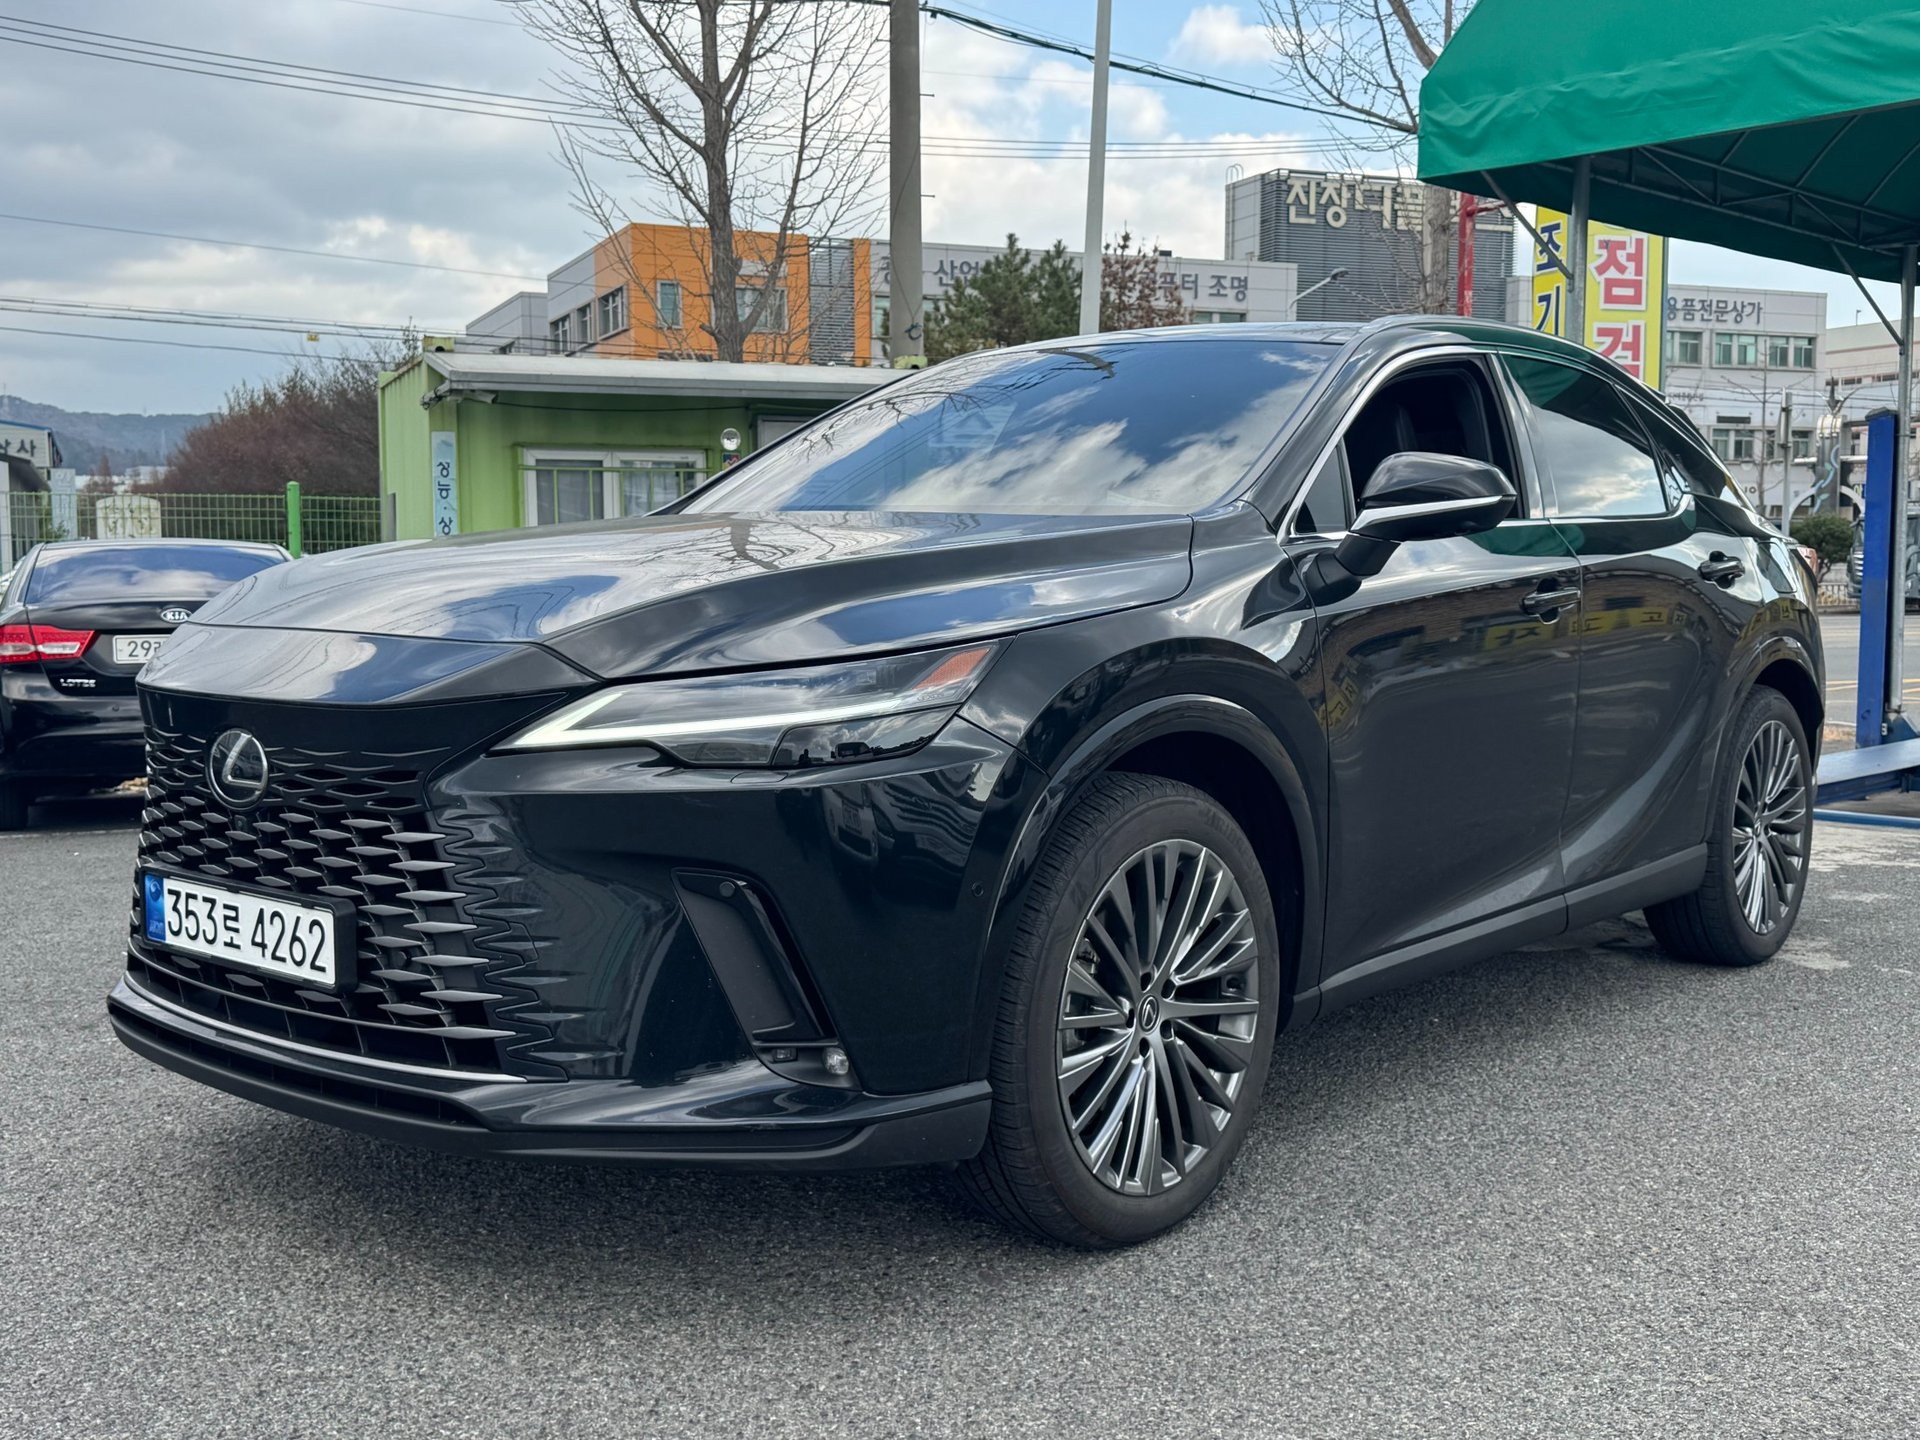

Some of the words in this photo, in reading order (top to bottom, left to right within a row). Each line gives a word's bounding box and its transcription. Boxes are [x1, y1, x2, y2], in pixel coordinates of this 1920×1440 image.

[1208, 274, 1248, 302] 조명
[1667, 296, 1763, 325] 용품전문상가
[166, 610, 188, 621] KIA
[167, 888, 242, 951] 353로
[251, 907, 327, 973] 4262
